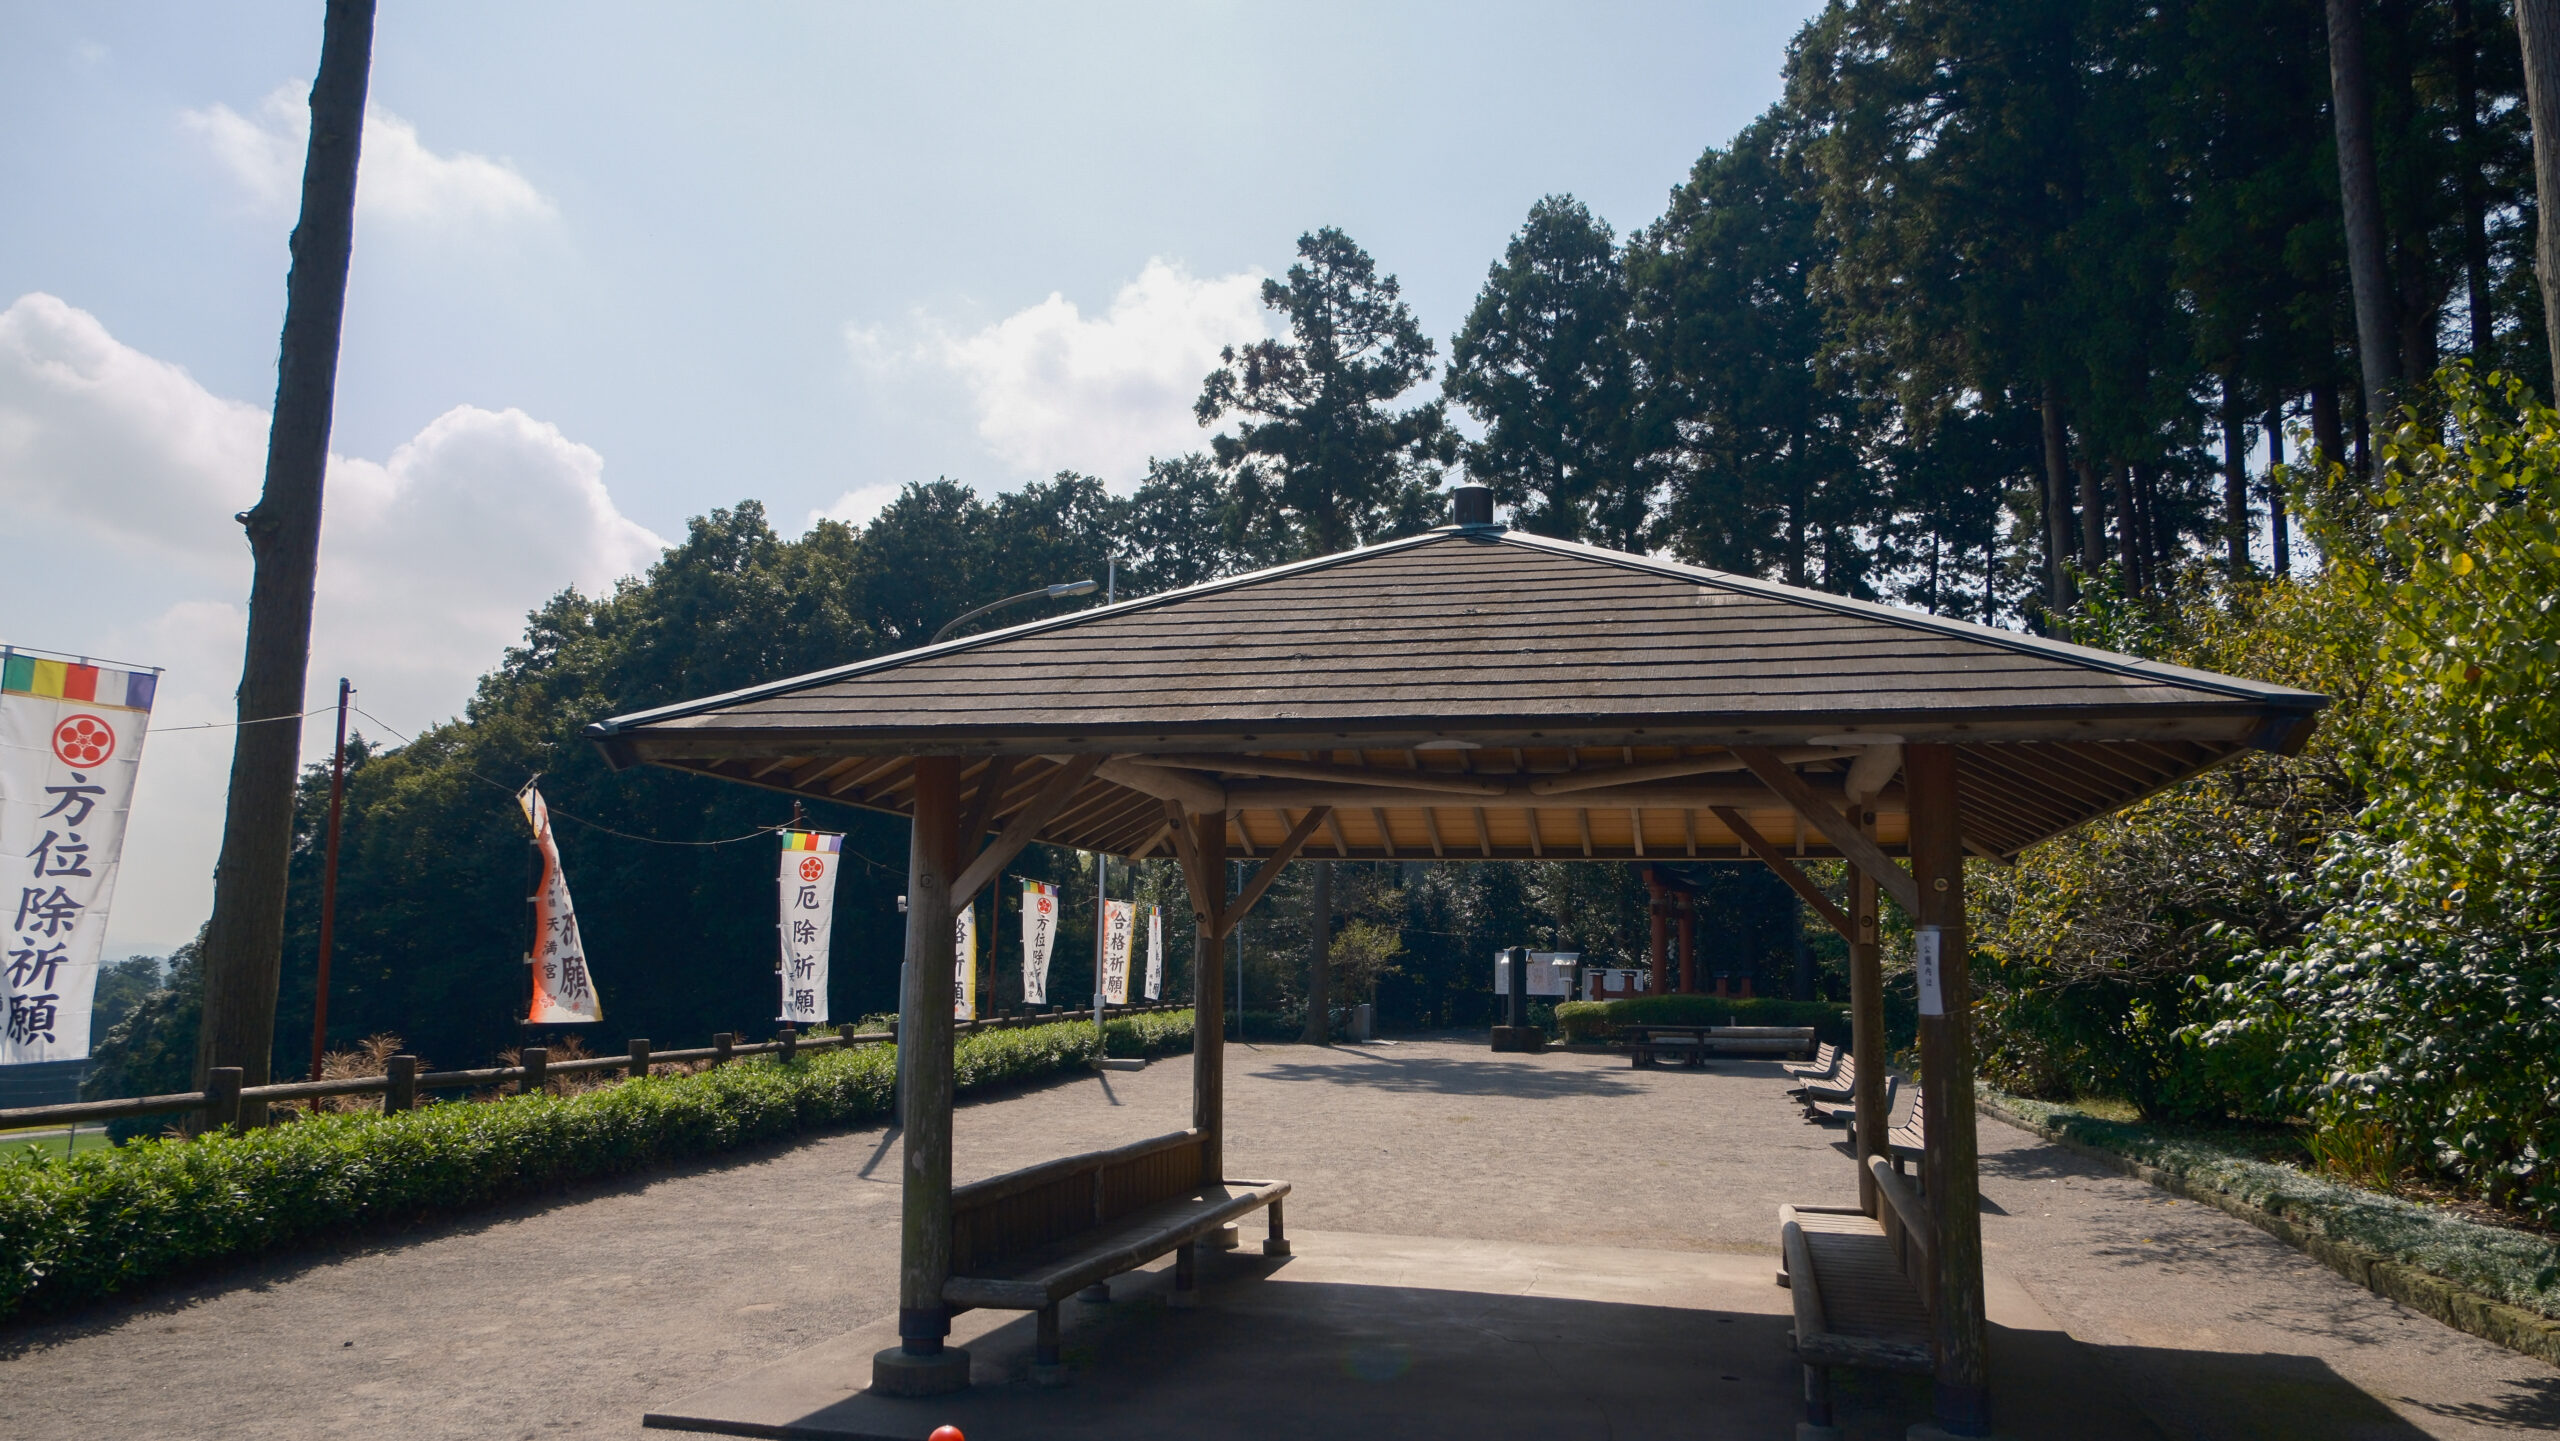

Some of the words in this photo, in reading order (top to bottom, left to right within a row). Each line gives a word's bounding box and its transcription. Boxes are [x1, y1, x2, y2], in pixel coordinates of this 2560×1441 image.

[3, 771, 107, 1047] 方位除祈願
[542, 917, 560, 980] 天満宮
[793, 884, 820, 1015] 厄除祈願
[1033, 915, 1050, 998] 方位除
[1107, 911, 1127, 995] 合格祈願
